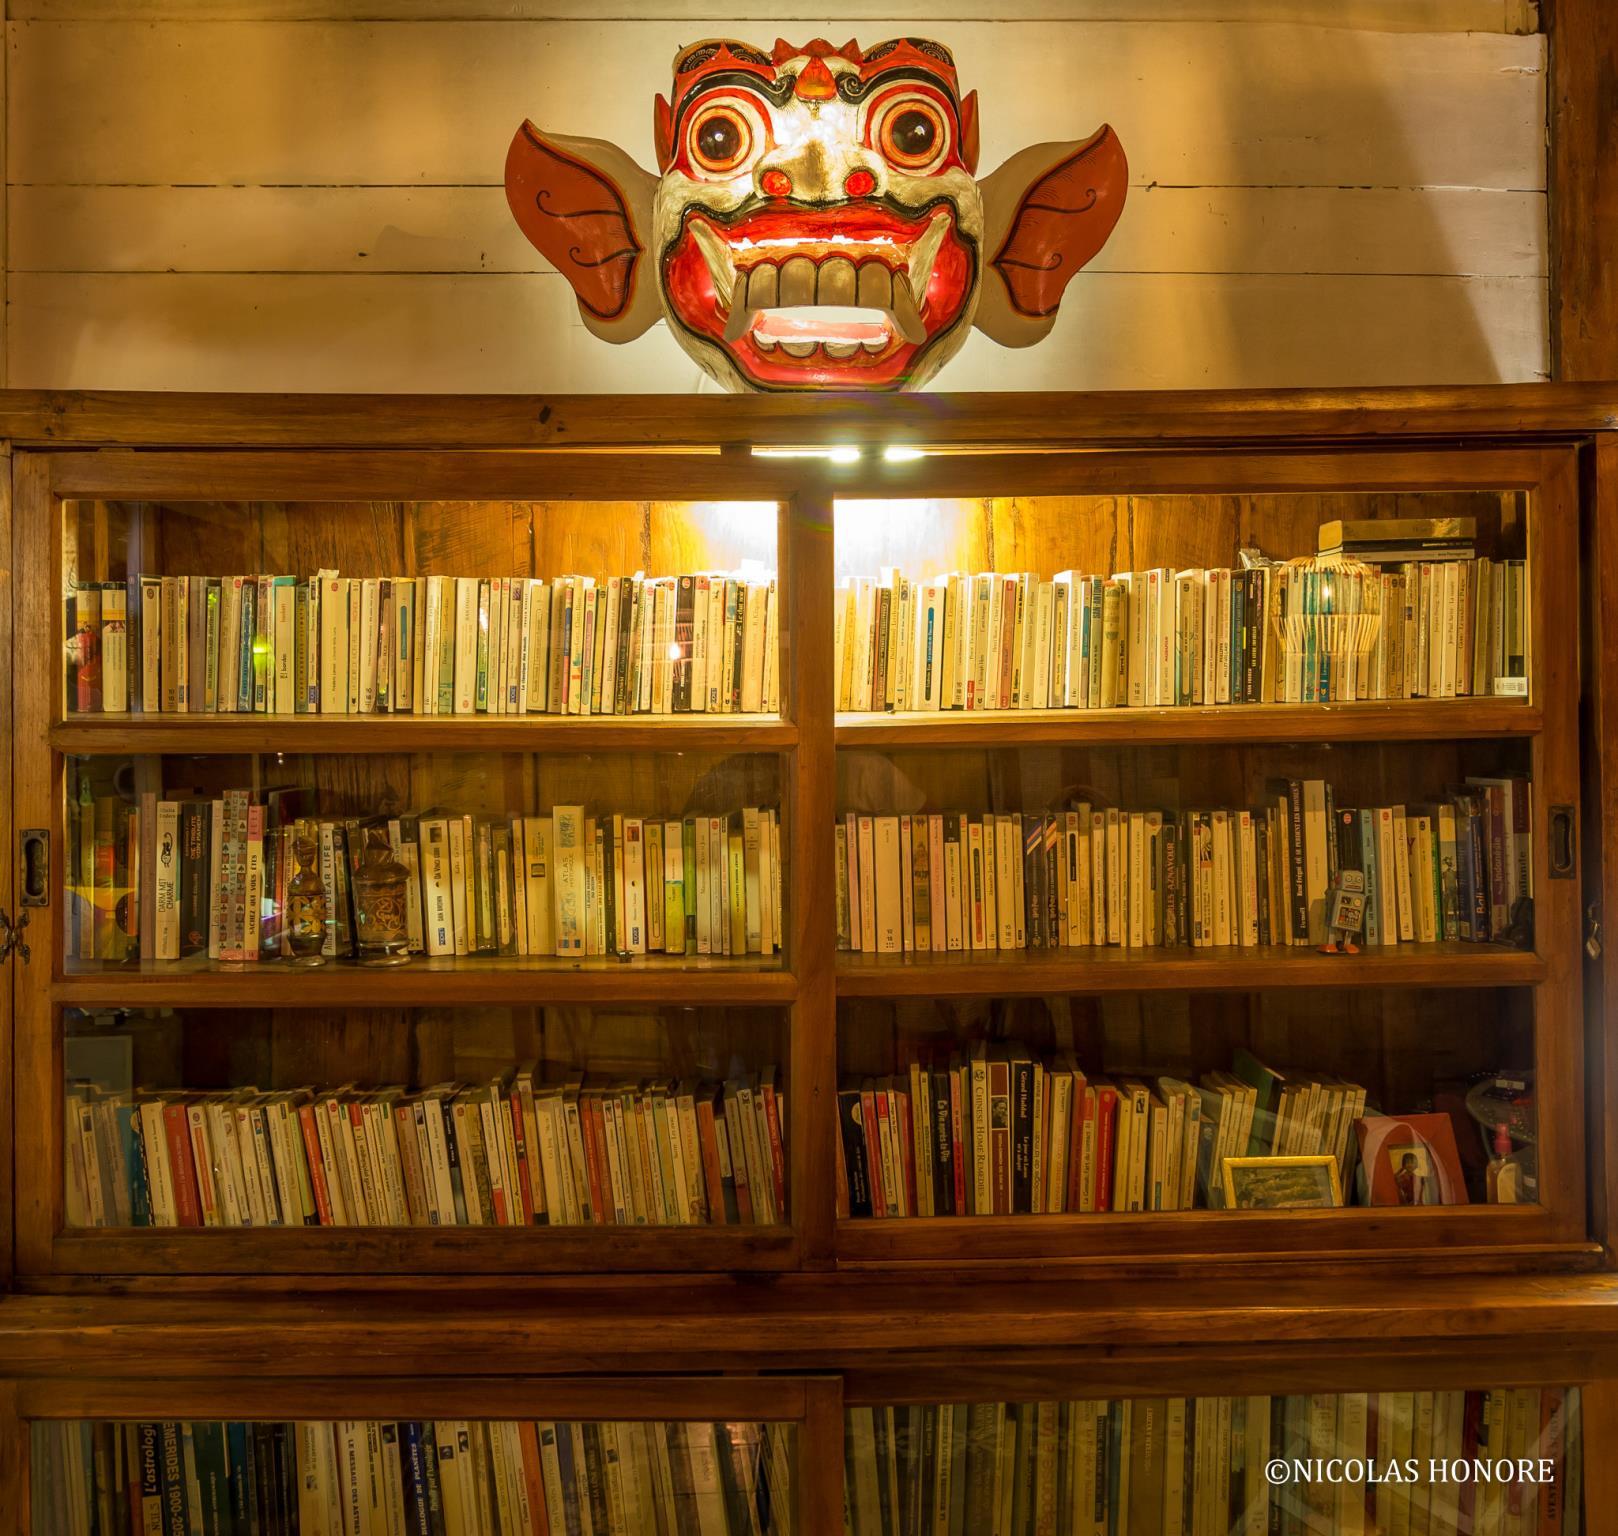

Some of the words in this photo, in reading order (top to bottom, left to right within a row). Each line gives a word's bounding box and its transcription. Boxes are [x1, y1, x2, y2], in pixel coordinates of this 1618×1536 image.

[1293, 812, 1301, 823] LES
[322, 844, 331, 869] LIFE
[1166, 842, 1175, 890] AZNAVOUR
[1493, 836, 1502, 882] Indonésie
[158, 878, 166, 891] MIT
[323, 873, 332, 904] DEAR
[158, 892, 166, 912] DARM
[1475, 891, 1486, 915] Bali
[1019, 1070, 1028, 1093] Gérard
[975, 1086, 985, 1125] CHINESE
[1019, 1093, 1027, 1118] Haddad
[976, 1126, 985, 1154] HOME
[977, 1154, 986, 1197] REMEDIES
[347, 1438, 355, 1449] LE
[141, 1424, 157, 1493] L'astrologi
[348, 1449, 358, 1487] MESSAGE
[351, 1488, 359, 1504] DES
[415, 1483, 423, 1494] DE
[168, 1484, 185, 1536] 1900-205
[352, 1505, 361, 1535] ASTRES
[416, 1496, 428, 1536] DIALOGUE
